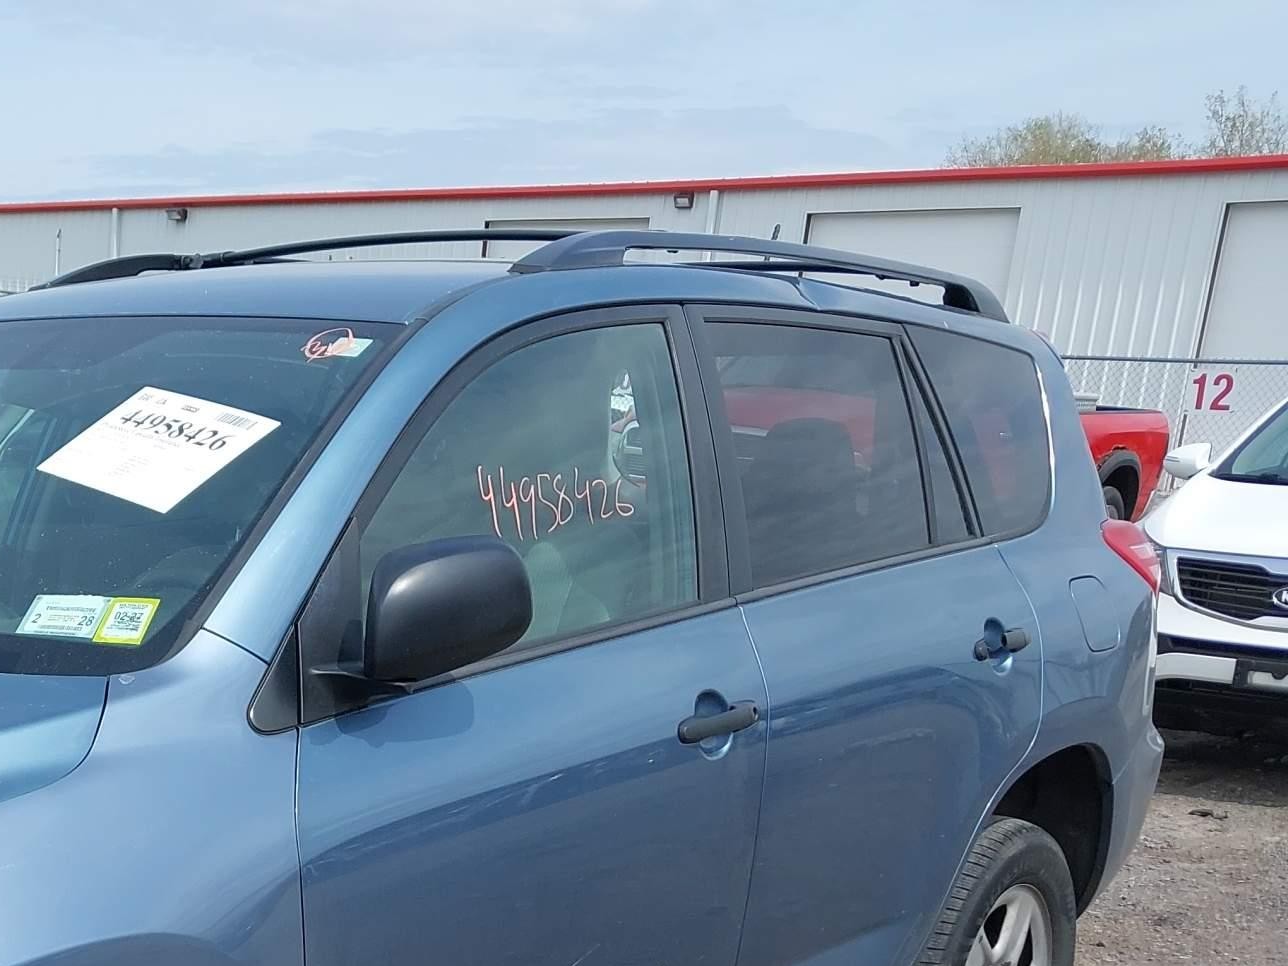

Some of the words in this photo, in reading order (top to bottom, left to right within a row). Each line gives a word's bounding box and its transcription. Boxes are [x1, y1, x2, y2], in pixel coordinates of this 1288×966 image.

[1193, 373, 1234, 411] 12
[120, 410, 236, 451] 44958426
[477, 465, 635, 541] 44958426
[31, 613, 42, 624] 2
[77, 615, 95, 627] 28
